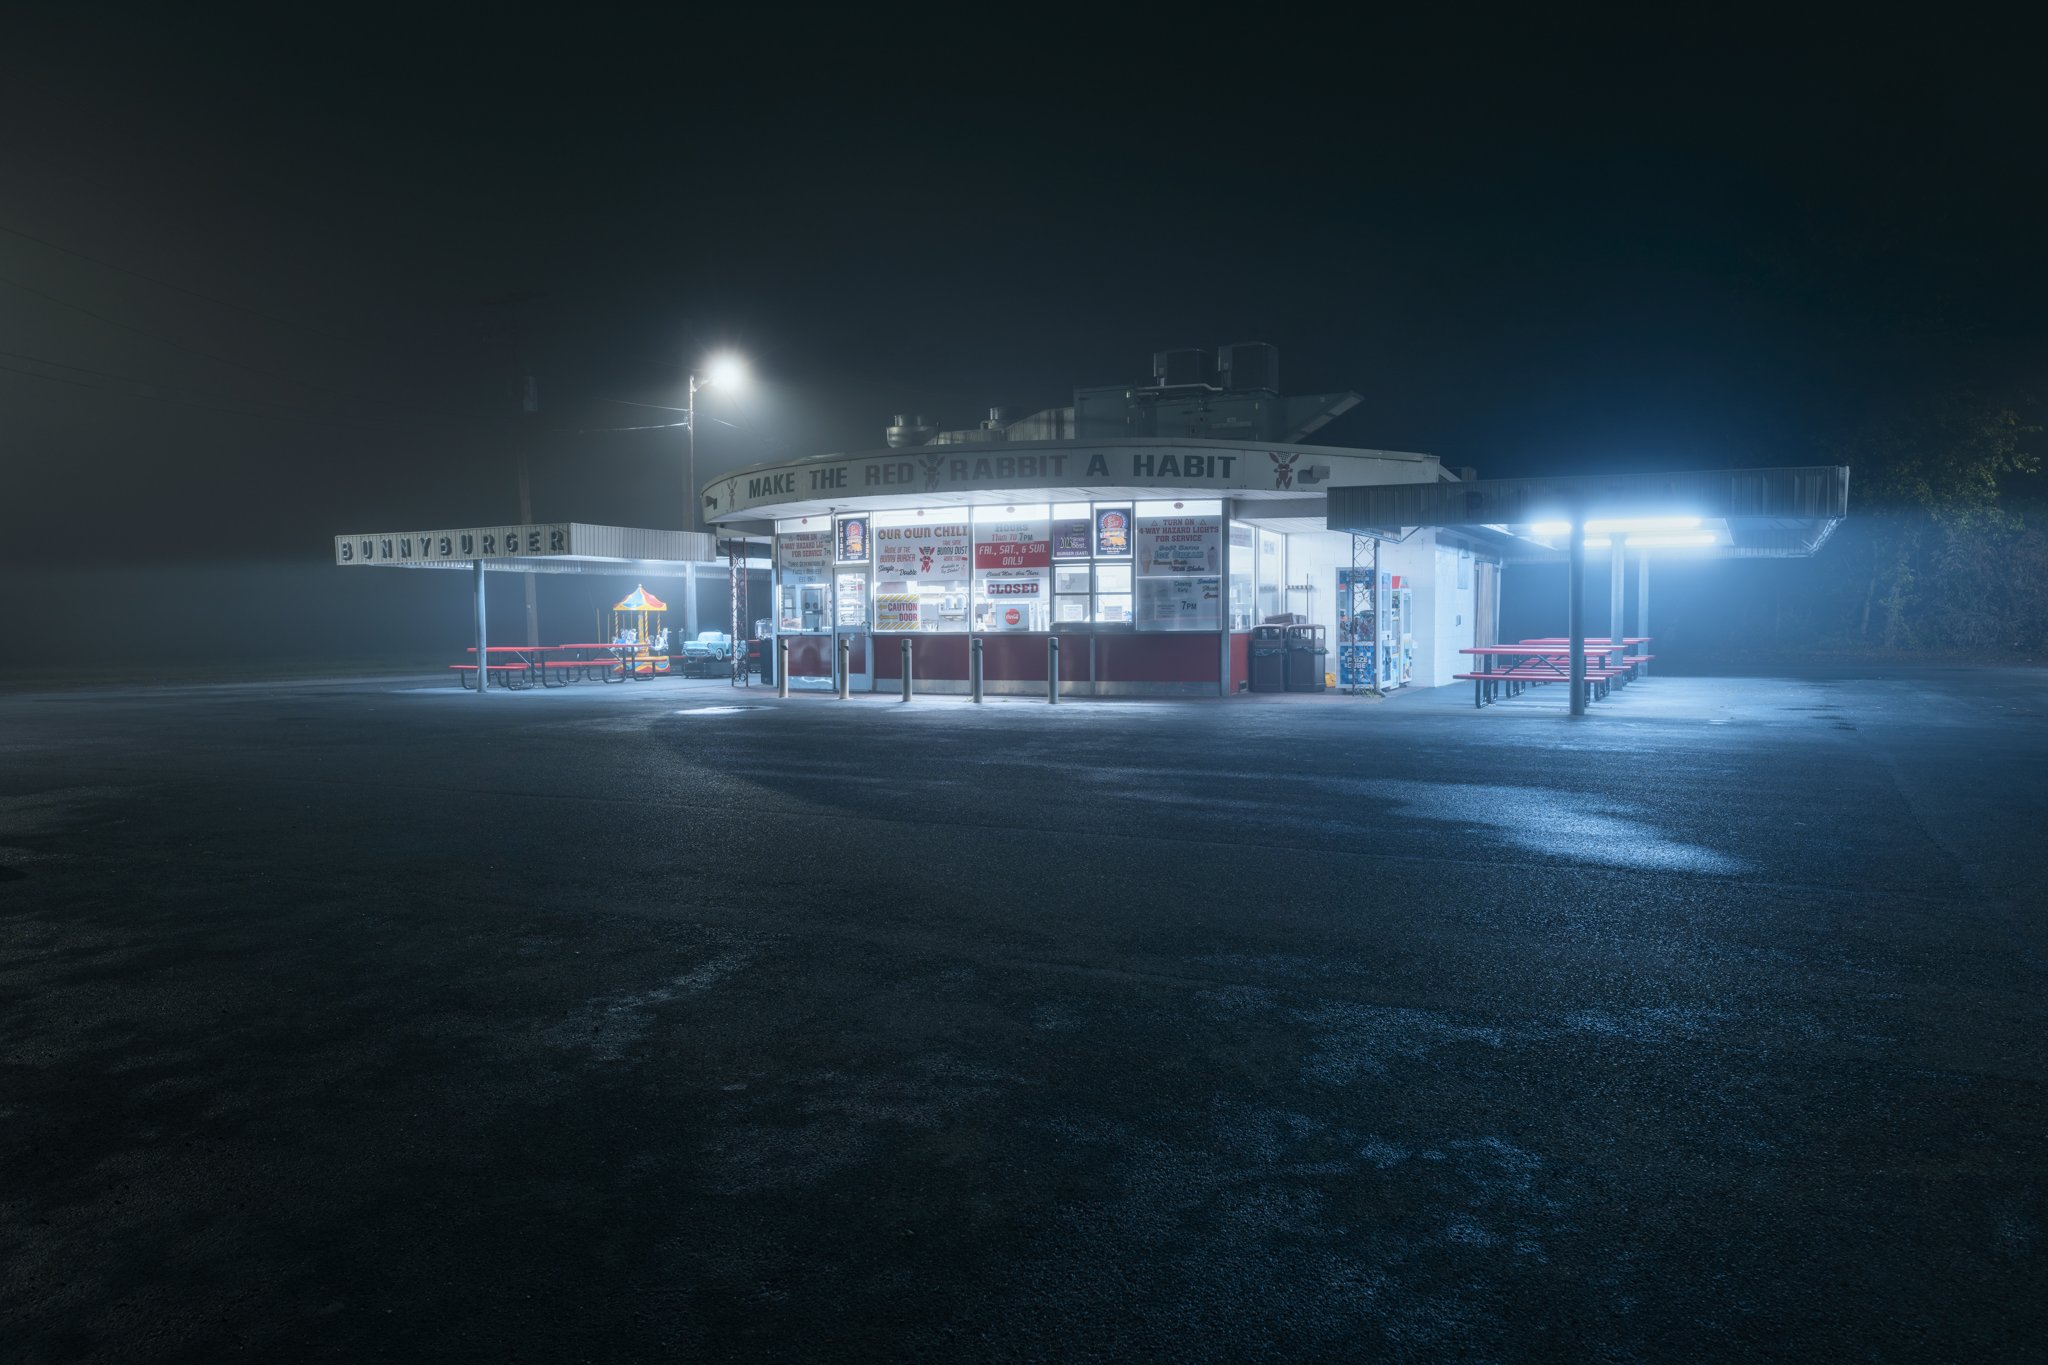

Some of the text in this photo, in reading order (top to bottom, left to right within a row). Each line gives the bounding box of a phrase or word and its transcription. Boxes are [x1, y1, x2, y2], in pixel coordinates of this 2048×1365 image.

[748, 454, 1236, 499] MAKE THE RED RABBIT A HABIT
[878, 525, 968, 540] OUR OWN CHILI
[1019, 533, 1033, 542] 7PM
[937, 546, 968, 556] BUNNY DUST
[979, 545, 997, 556] FRI.,
[1000, 544, 1019, 555] SAT.,
[1028, 544, 1047, 553] SUN.
[897, 553, 916, 562] BURGER
[1002, 556, 1024, 566] ONLY
[900, 568, 918, 576] Double
[987, 583, 1039, 595] CLOSED
[888, 603, 918, 611] CAUTION
[1181, 601, 1197, 610] 7PM
[898, 613, 918, 621] DOOR
